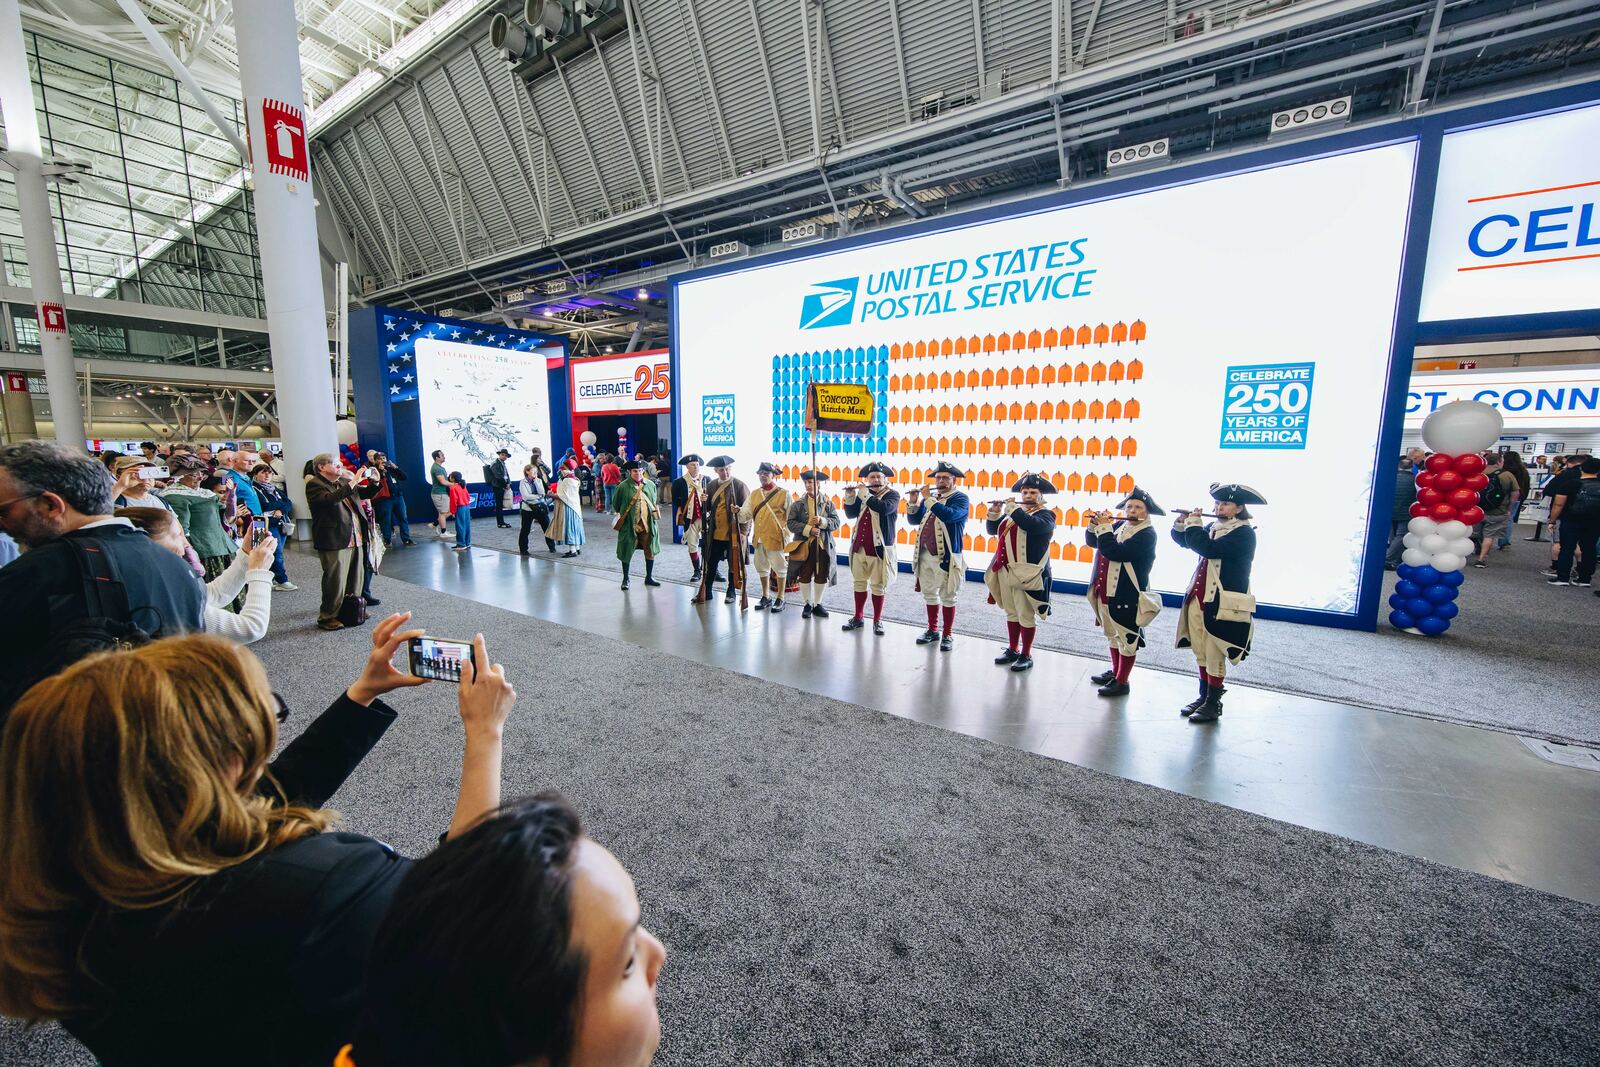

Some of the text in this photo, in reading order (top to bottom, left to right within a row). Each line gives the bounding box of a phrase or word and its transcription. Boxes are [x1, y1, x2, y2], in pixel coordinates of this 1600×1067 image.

[1468, 203, 1600, 258] CEL
[866, 237, 1088, 295] UNITED STATES
[860, 269, 1097, 323] POSTAL SERVICE
[580, 363, 670, 401] CELEBRATE 25
[1230, 369, 1310, 382] CELEBRATE
[820, 395, 860, 405] CONCORD
[1226, 382, 1309, 413] 250
[703, 406, 734, 425] 250
[820, 404, 866, 415] Minute Men
[1225, 415, 1305, 428] YEARS OF
[703, 425, 734, 433] YEARS OF
[703, 434, 734, 442] AMERICA
[1223, 430, 1303, 442] AMERICA
